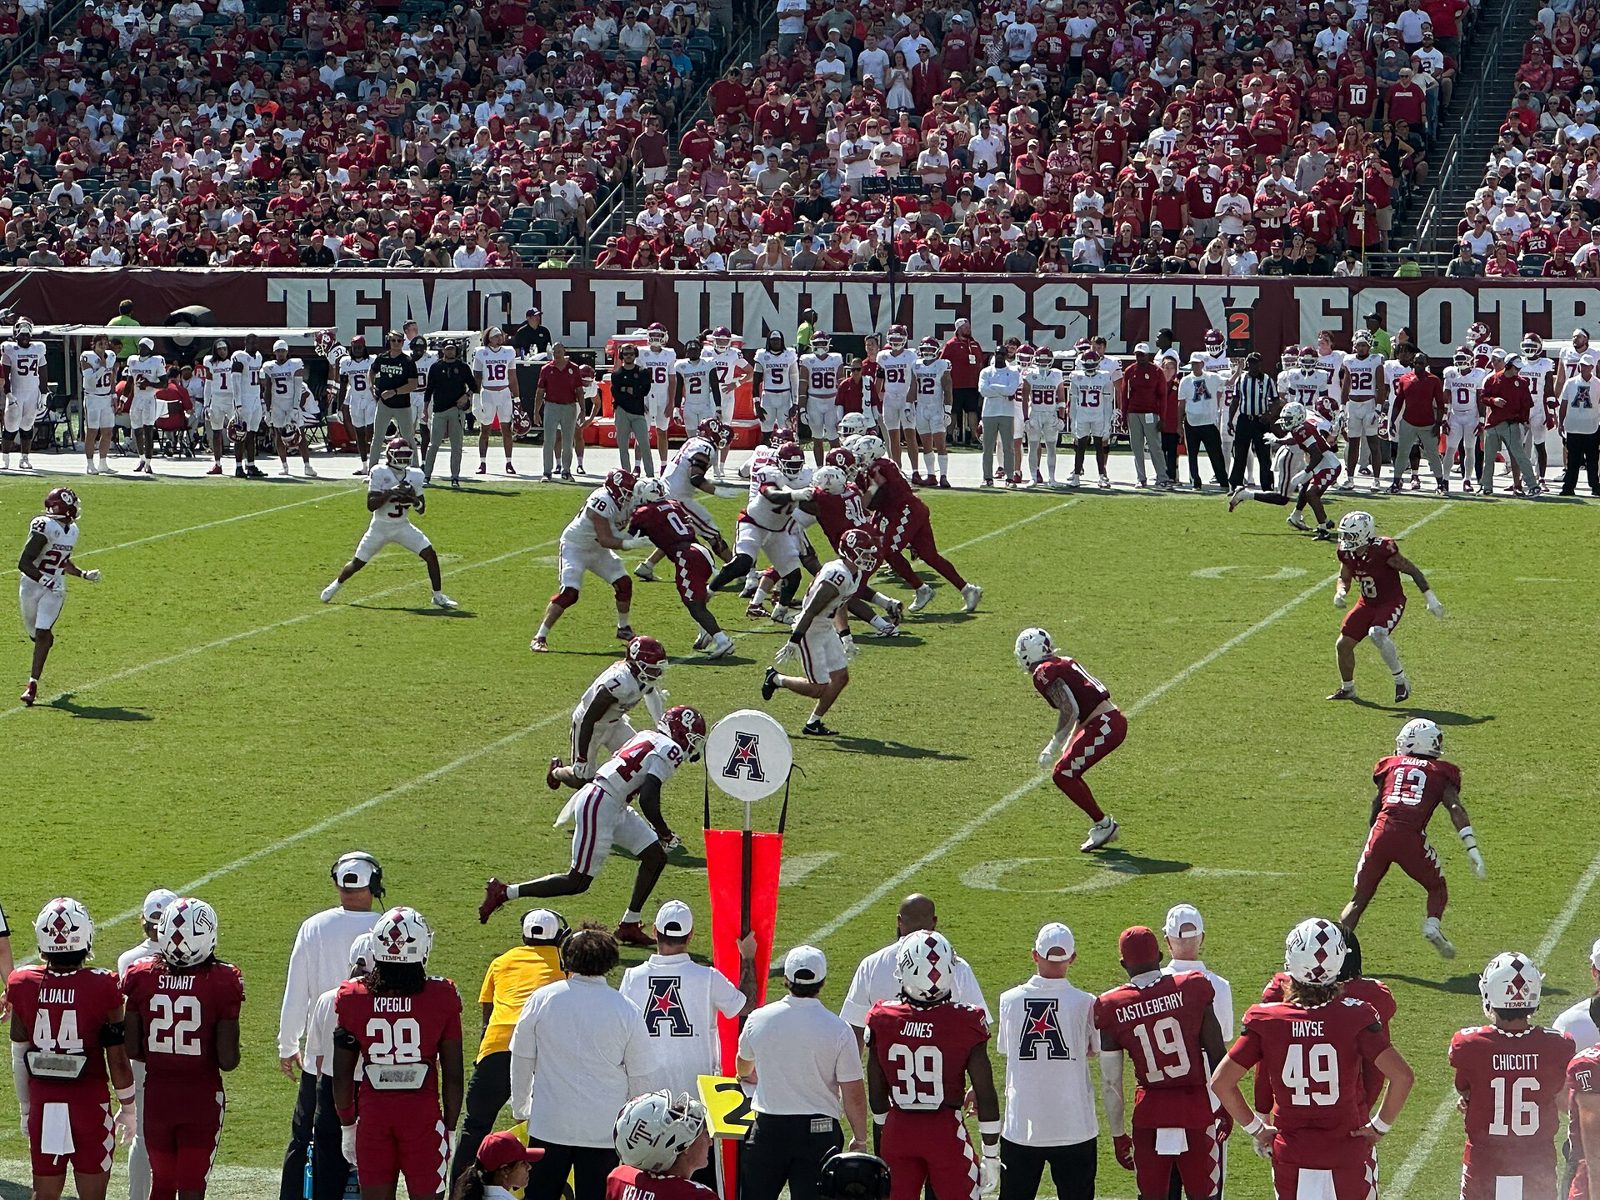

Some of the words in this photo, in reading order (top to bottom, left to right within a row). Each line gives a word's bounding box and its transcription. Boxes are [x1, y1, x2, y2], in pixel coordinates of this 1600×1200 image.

[1349, 88, 1367, 105] 10
[266, 278, 644, 348] TEMPLE
[674, 280, 1260, 354] UNIVERSITY
[1228, 312, 1250, 339] 2
[17, 358, 39, 377] 54
[486, 364, 507, 381] 18
[771, 368, 784, 385] 5
[220, 373, 228, 390] 1
[274, 377, 288, 395] 5
[353, 374, 367, 391] 6
[689, 377, 702, 394] 2
[811, 372, 836, 389] 86
[916, 377, 935, 395] 12
[1080, 389, 1101, 408] 13
[1192, 378, 1213, 403] A
[1298, 389, 1317, 406] 17
[1457, 388, 1470, 405] 0
[1570, 385, 1593, 409] A
[591, 496, 607, 512] 78
[32, 519, 47, 533] 24
[666, 510, 689, 536] 0
[829, 570, 846, 587] 19
[608, 678, 621, 692] 7
[722, 731, 765, 782] A
[1387, 767, 1428, 806] 13
[158, 975, 196, 990] STUART
[38, 988, 76, 1004] ALUALU
[373, 997, 412, 1013] KPEGLO
[643, 975, 694, 1037] A
[1115, 990, 1184, 1024] CASTLEBERRY
[33, 1008, 84, 1055] 44
[148, 993, 202, 1056] 22
[899, 1020, 935, 1039] JONES
[1018, 998, 1070, 1061] A
[1291, 1021, 1325, 1037] HAYSE
[366, 1017, 422, 1065] 28
[1133, 1016, 1191, 1084] 19
[1492, 1053, 1540, 1071] CHICCITT
[887, 1043, 945, 1111] 39
[1281, 1043, 1340, 1106] 49
[1575, 1070, 1593, 1092] T
[714, 1082, 756, 1127] 2
[1488, 1077, 1541, 1137] 16
[628, 1118, 655, 1147] T
